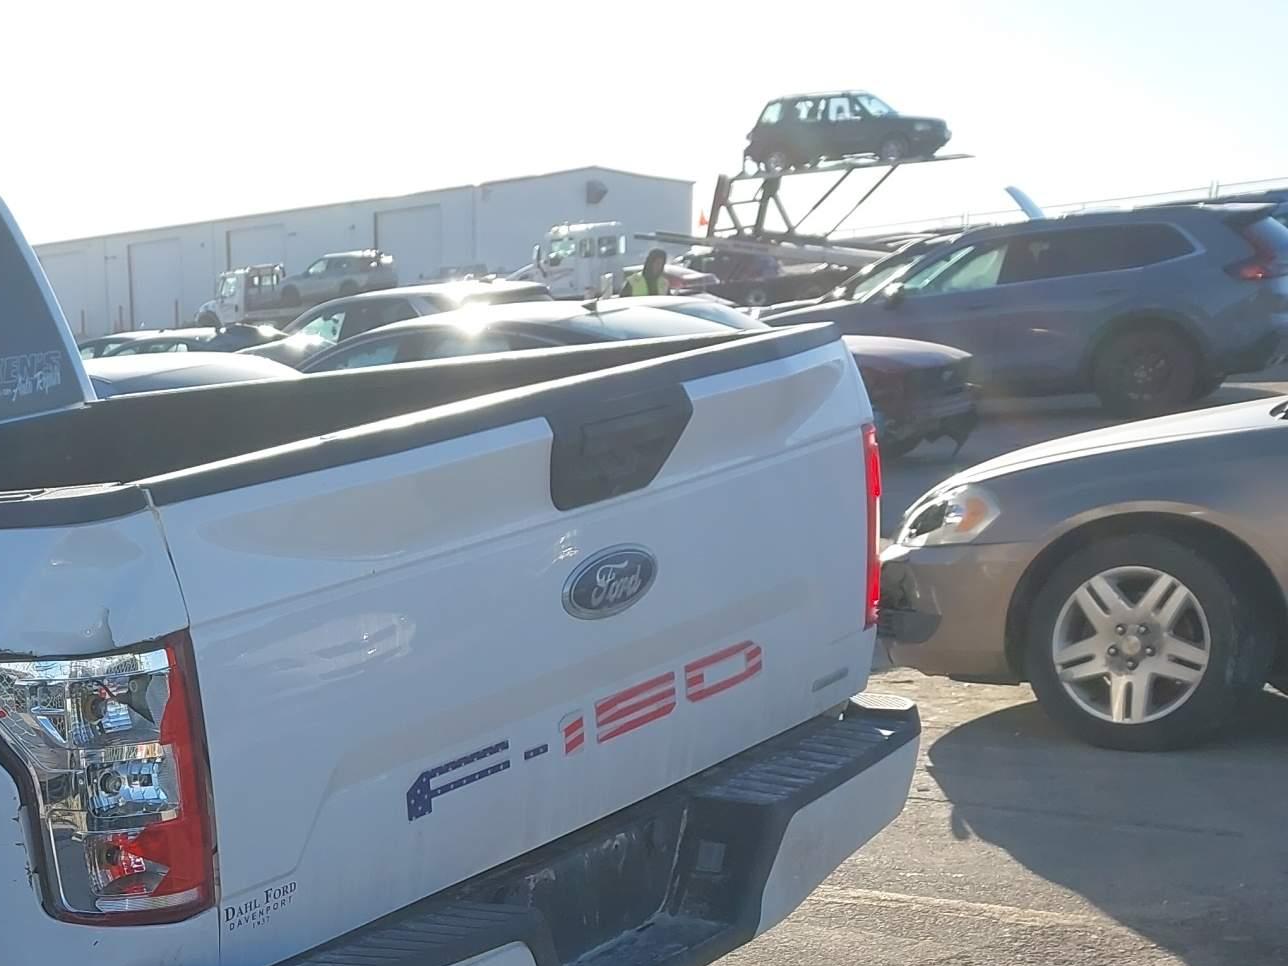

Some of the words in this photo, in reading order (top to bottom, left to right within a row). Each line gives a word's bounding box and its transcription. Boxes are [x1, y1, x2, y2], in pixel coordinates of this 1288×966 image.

[590, 559, 642, 607] Ford
[406, 639, 763, 822] F-150
[224, 899, 260, 923] DAHL
[263, 882, 297, 905] FORD
[229, 896, 293, 931] DAVENPORT
